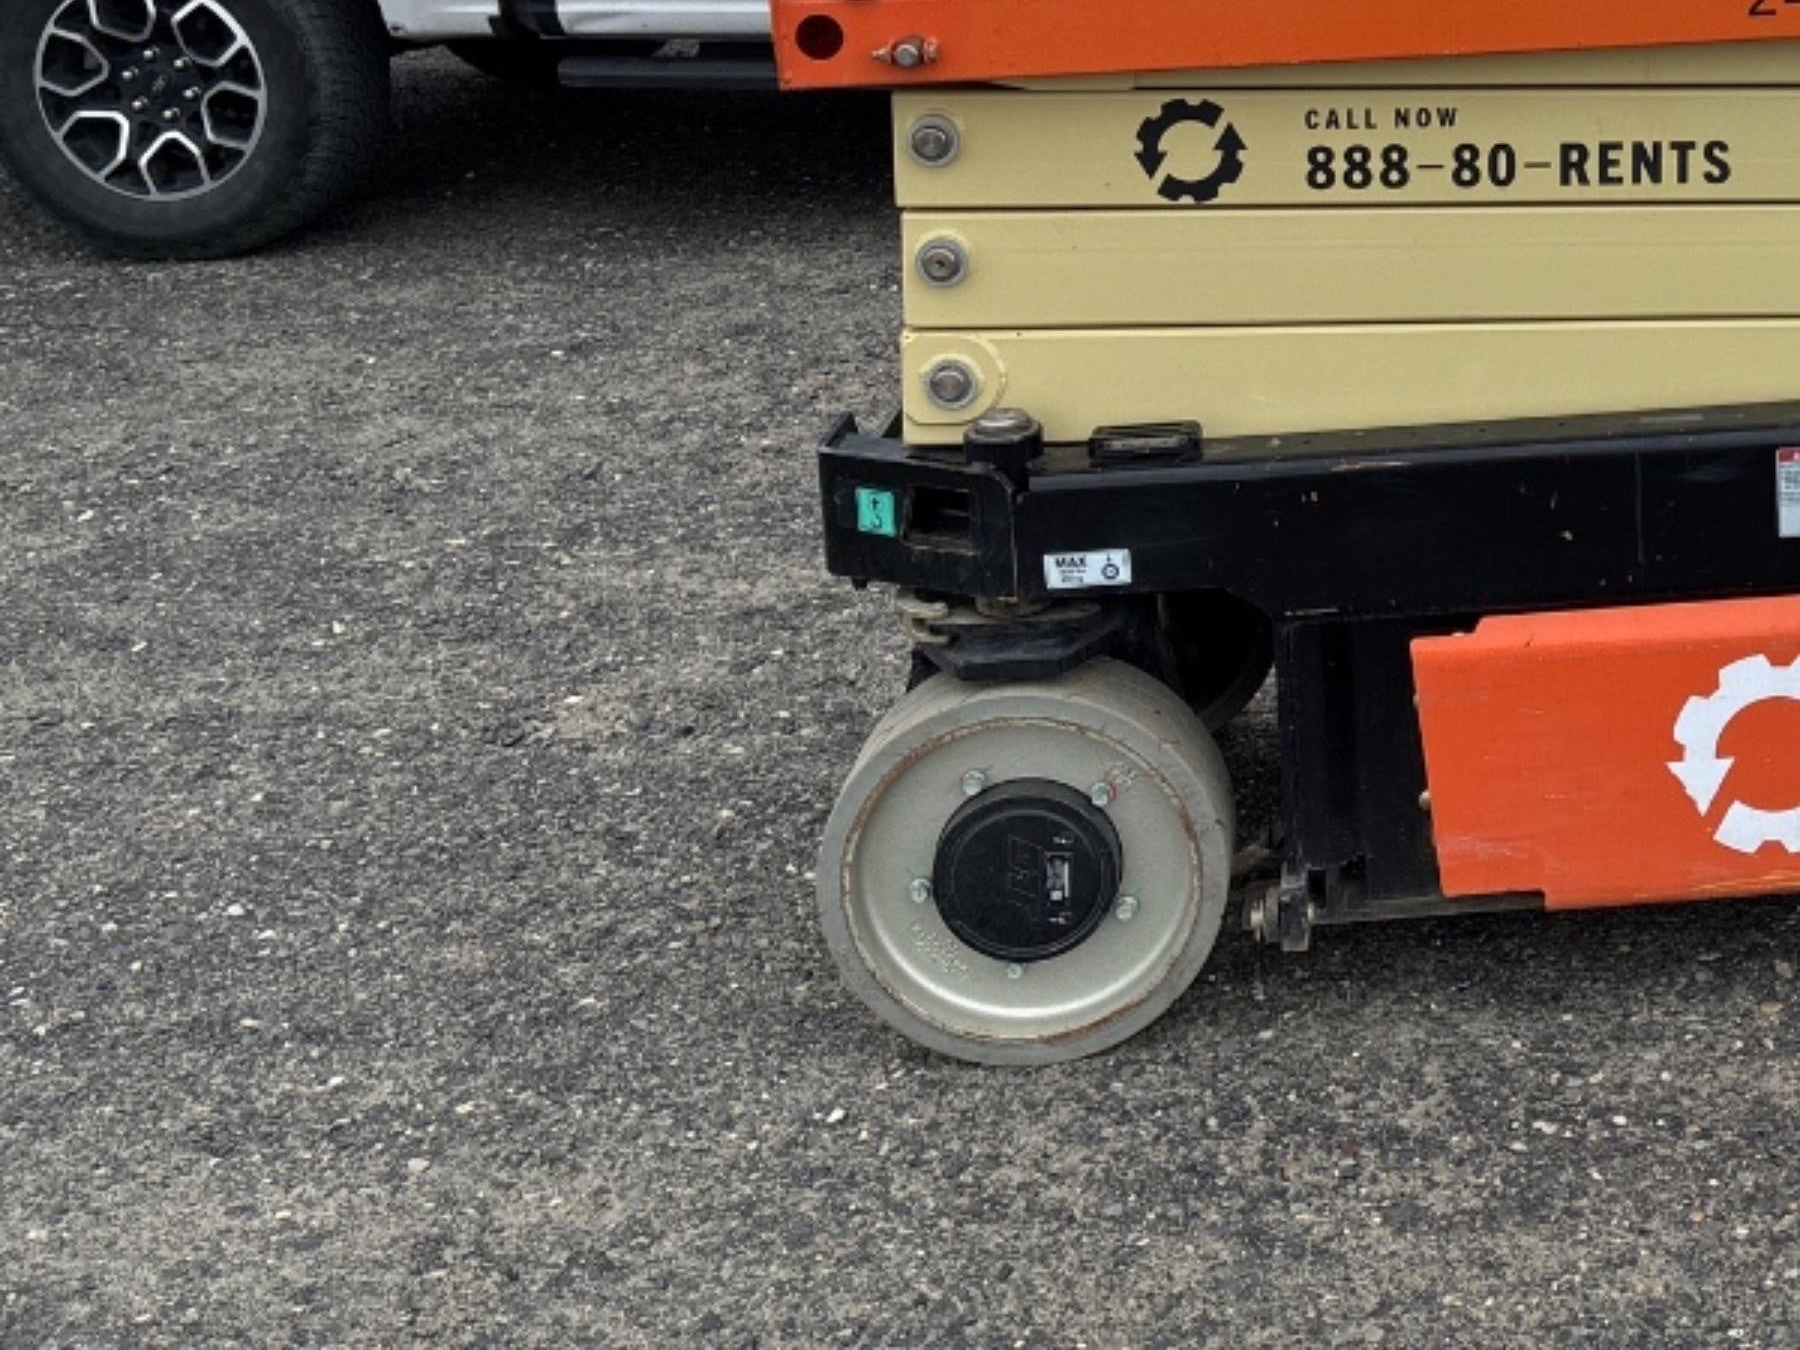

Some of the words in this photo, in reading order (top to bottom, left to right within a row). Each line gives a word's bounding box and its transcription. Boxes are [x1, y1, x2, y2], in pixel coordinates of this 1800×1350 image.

[1304, 107, 1378, 130] CALL
[1394, 106, 1458, 129] NOW
[1305, 139, 1732, 190] 888-80-RENTS
